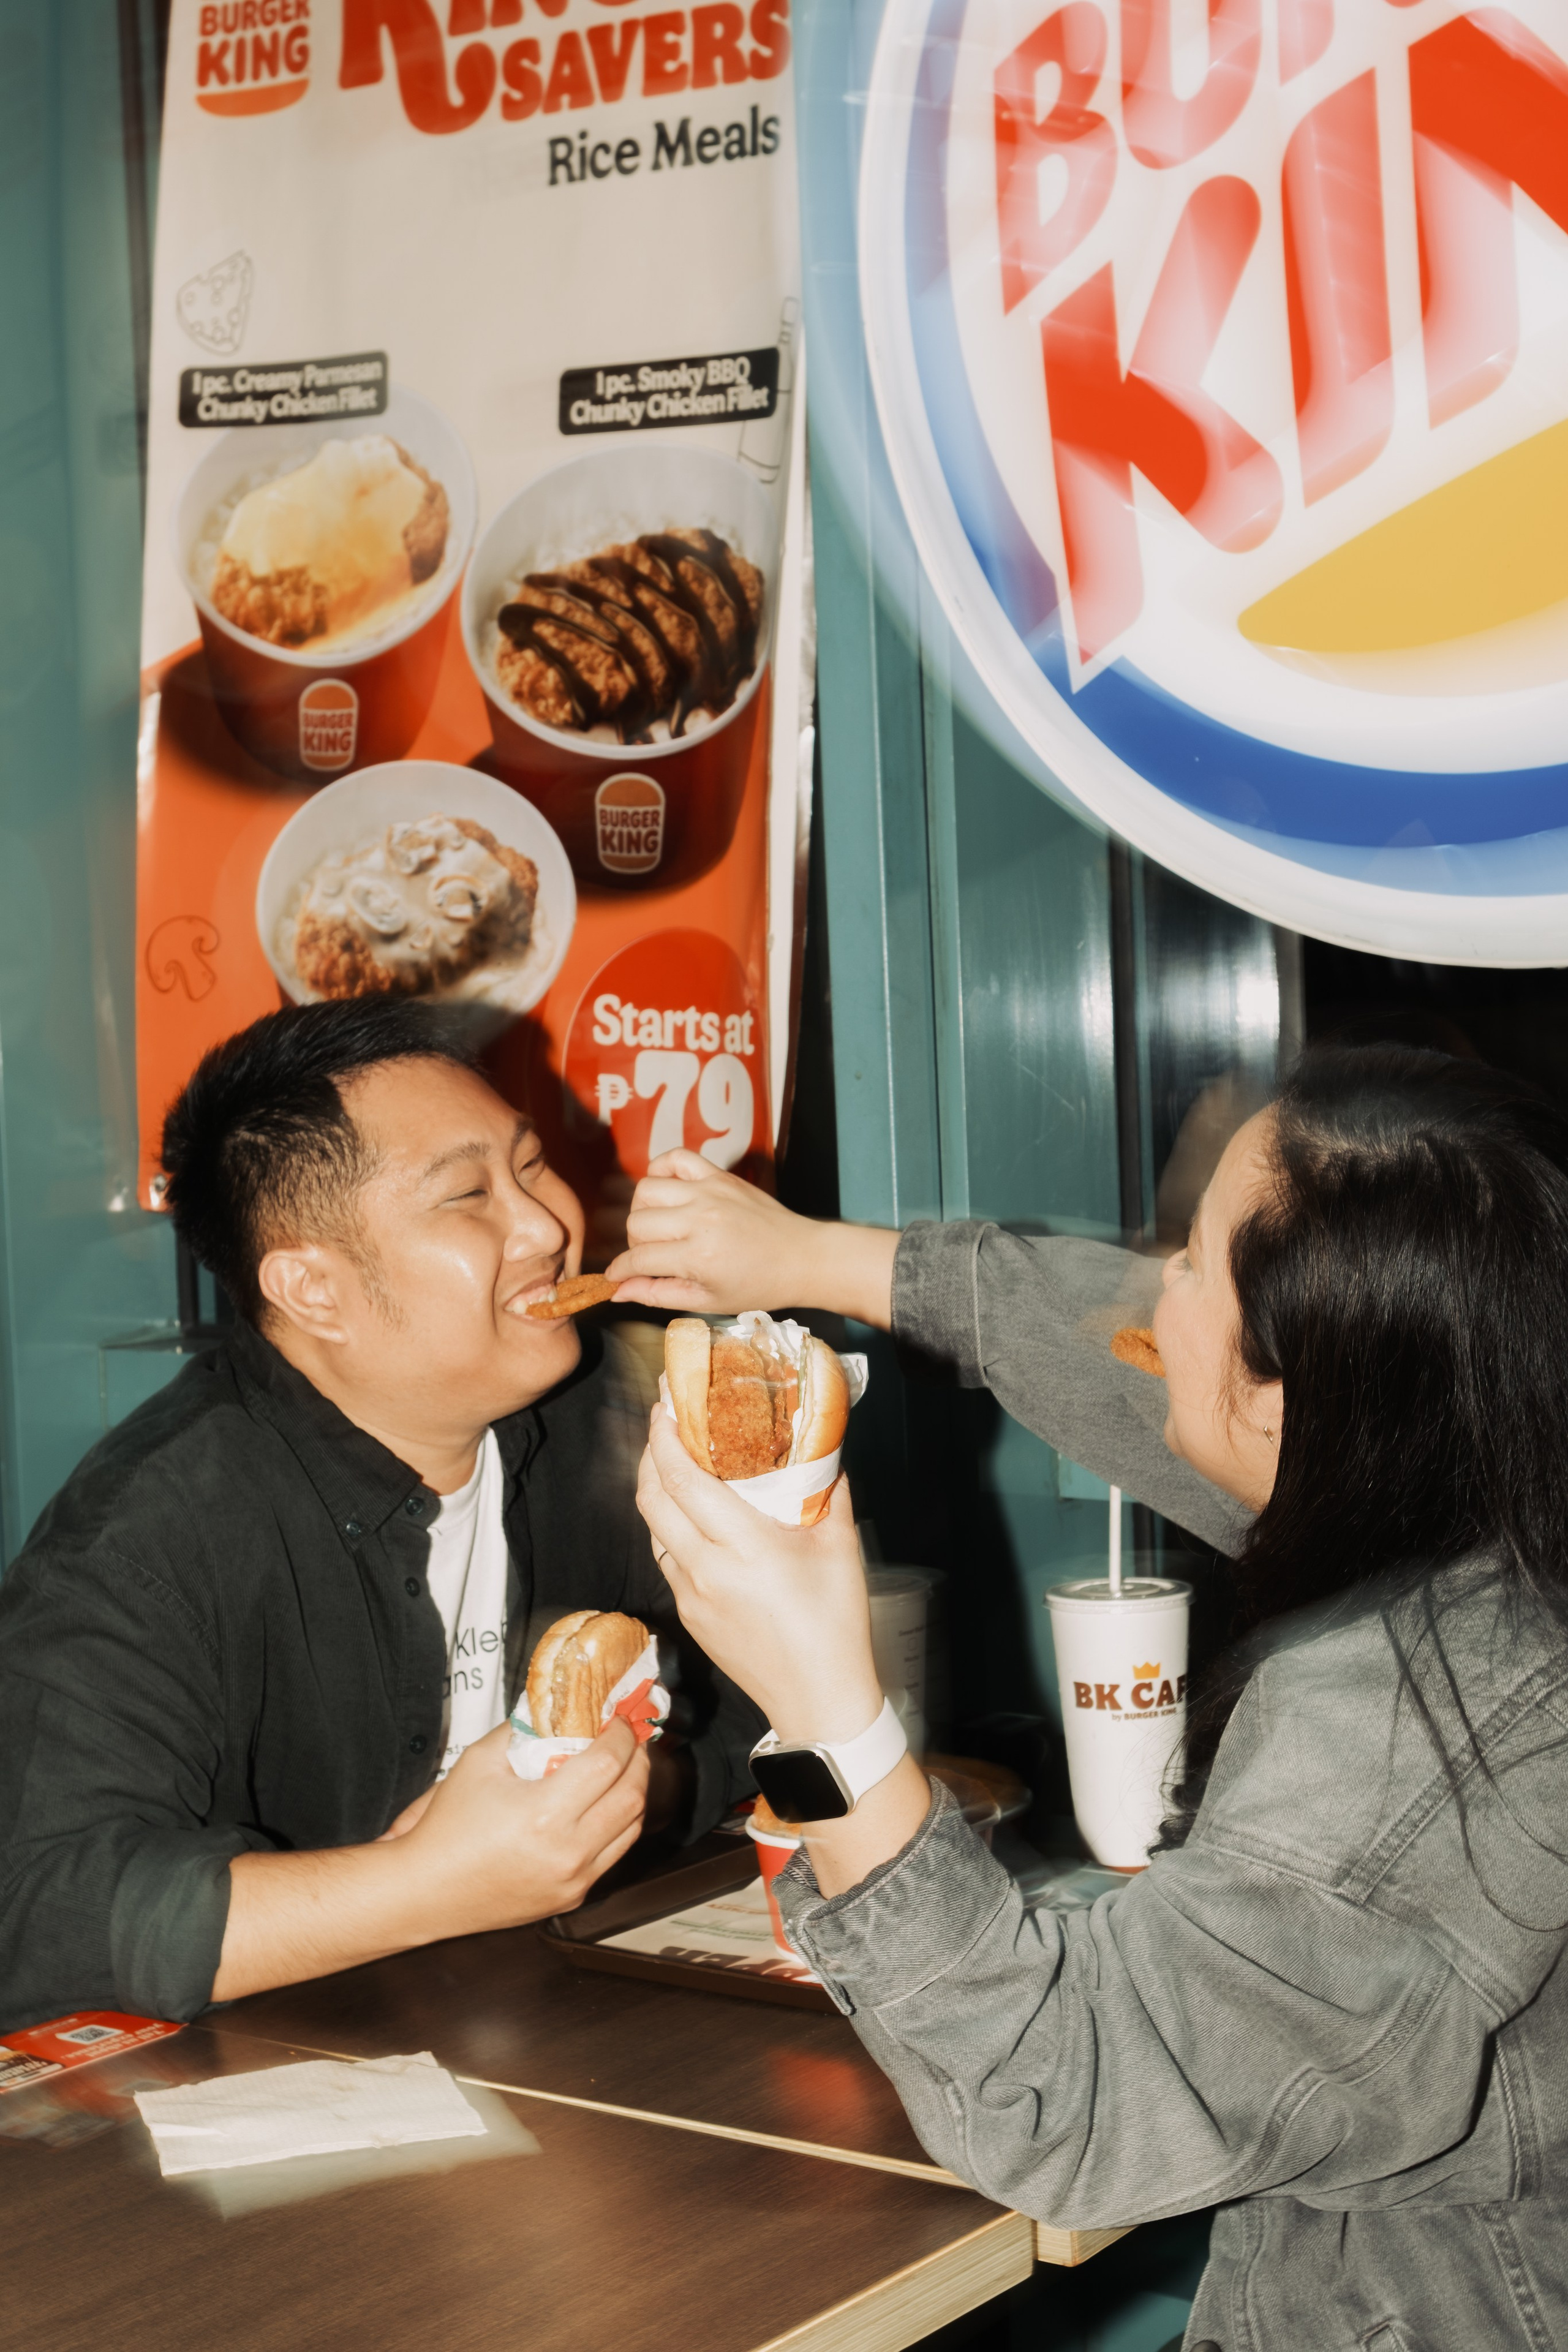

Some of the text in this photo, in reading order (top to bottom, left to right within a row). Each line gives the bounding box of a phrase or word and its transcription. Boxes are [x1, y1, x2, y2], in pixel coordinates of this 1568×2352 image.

[200, 0, 309, 37] BURGER
[197, 24, 310, 88] KING
[500, 0, 791, 123] SAVERS
[548, 105, 780, 186] Rice Meals
[233, 369, 304, 398] Creamy
[304, 361, 382, 388] Parmesan
[637, 363, 706, 397] Smoky
[707, 356, 752, 386] BBQ
[197, 385, 377, 423] Chunky Chicken Fillet
[570, 384, 770, 426] Chunky Chicken Fillet
[304, 731, 352, 752] KING
[600, 809, 660, 827] BURGER
[601, 828, 658, 854] KING
[593, 993, 755, 1055] Starts at
[1073, 1681, 1122, 1710] BK
[1124, 1711, 1158, 1720] BURGER
